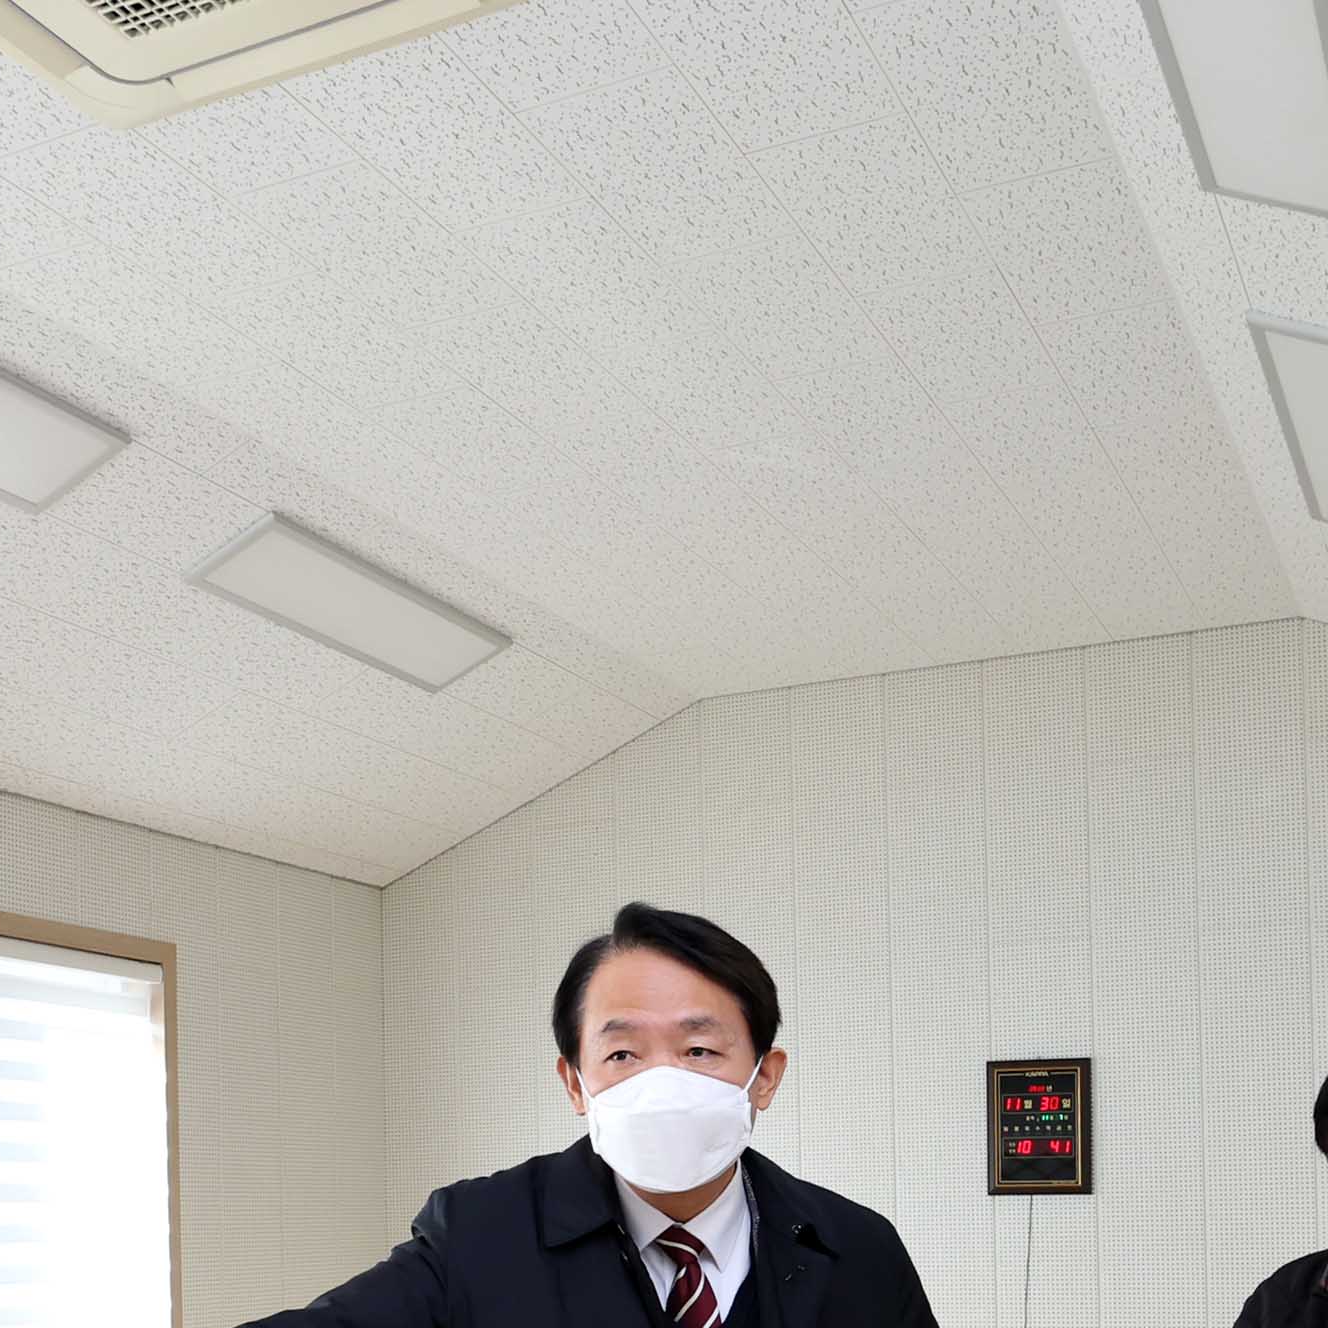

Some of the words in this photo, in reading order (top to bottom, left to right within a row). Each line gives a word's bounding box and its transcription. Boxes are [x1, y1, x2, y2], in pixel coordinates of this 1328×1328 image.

[1006, 1097, 1021, 1111] 11
[1040, 1096, 1060, 1112] 30
[1017, 1140, 1032, 1154] 10
[1050, 1140, 1070, 1153] 41
